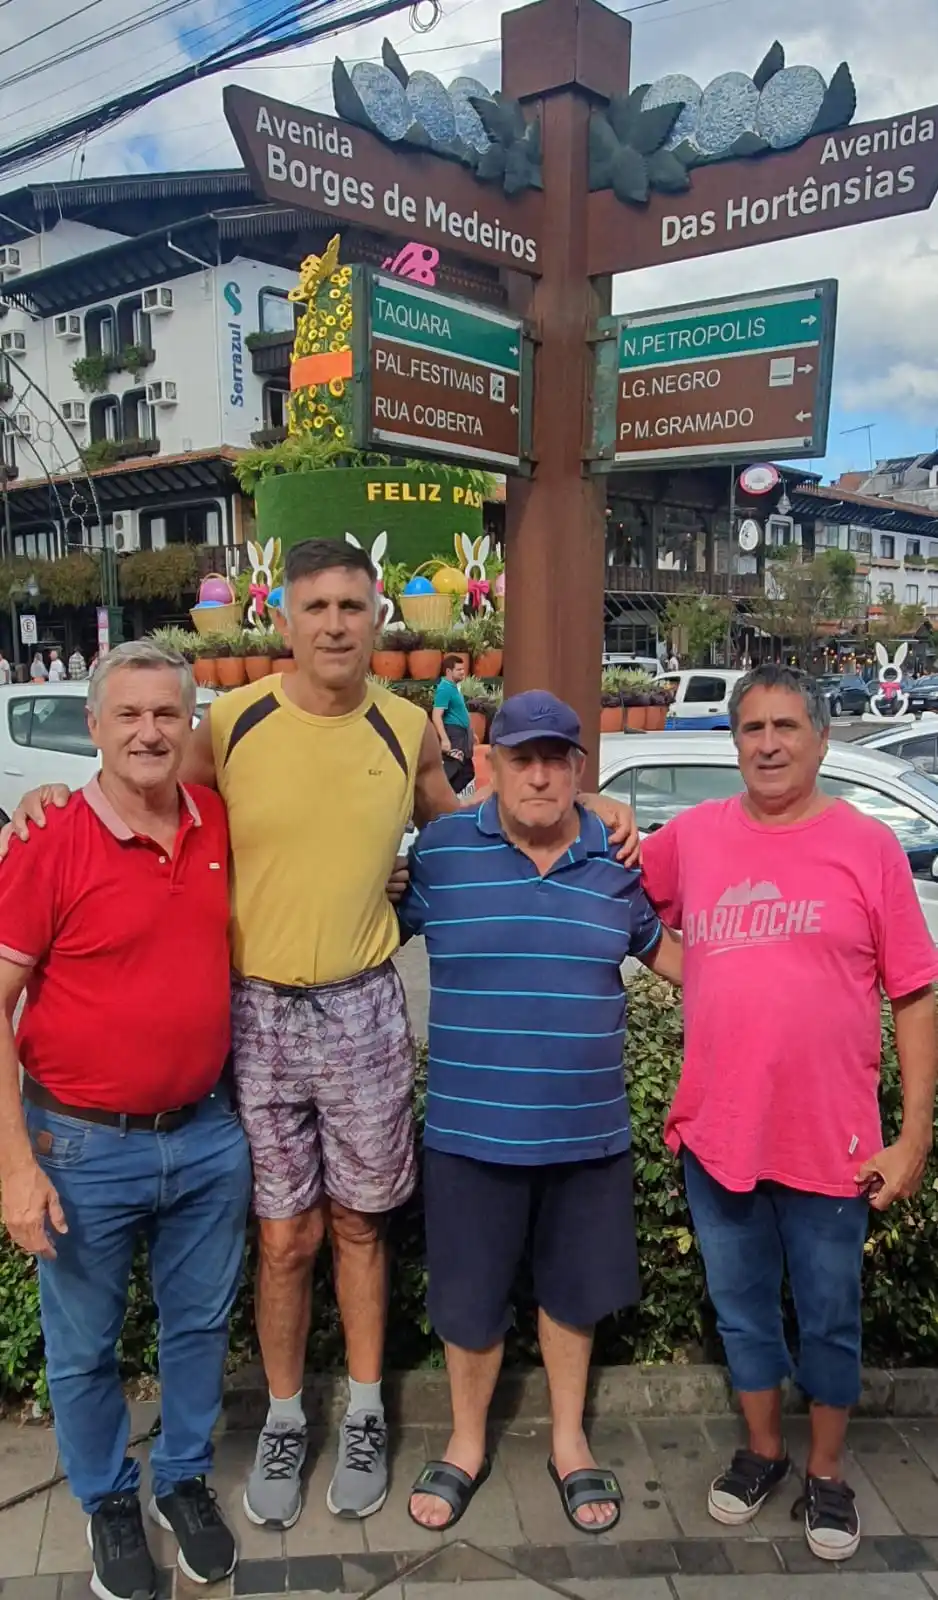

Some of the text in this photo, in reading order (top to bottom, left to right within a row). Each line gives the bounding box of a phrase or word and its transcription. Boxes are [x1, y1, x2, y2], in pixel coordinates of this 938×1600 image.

[255, 106, 353, 159] Avenida
[819, 117, 935, 165] Avenida
[266, 143, 537, 263] Borges de Medeiros
[661, 164, 916, 247] Das Hortênsias
[375, 297, 452, 339] TAQUARA
[623, 317, 766, 357] N.PETROPOLIS
[227, 322, 244, 408] Serrazul
[375, 349, 485, 395] PAL.FESTIVAIS
[622, 369, 721, 399] LG.NEGRO
[374, 396, 484, 436] RUA COBERTA
[367, 482, 483, 508] FELIZ PÁS
